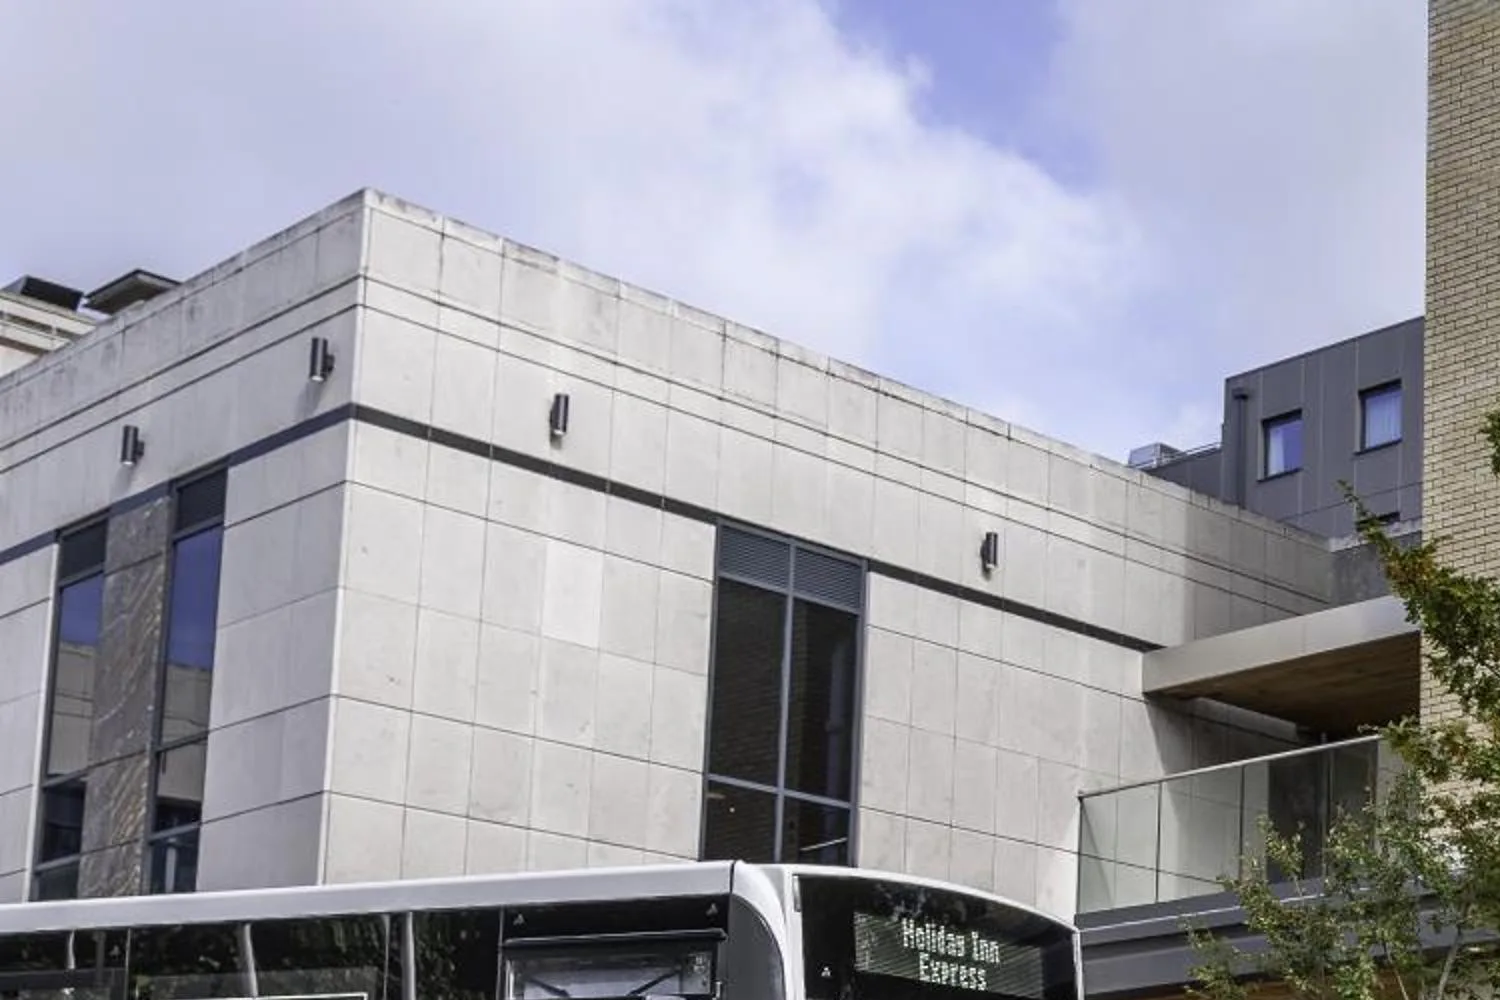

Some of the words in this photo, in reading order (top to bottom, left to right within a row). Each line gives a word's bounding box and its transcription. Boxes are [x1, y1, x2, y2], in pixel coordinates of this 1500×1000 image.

[902, 918, 965, 957] Holiday
[971, 931, 1000, 963] Inn
[919, 951, 987, 991] Express
